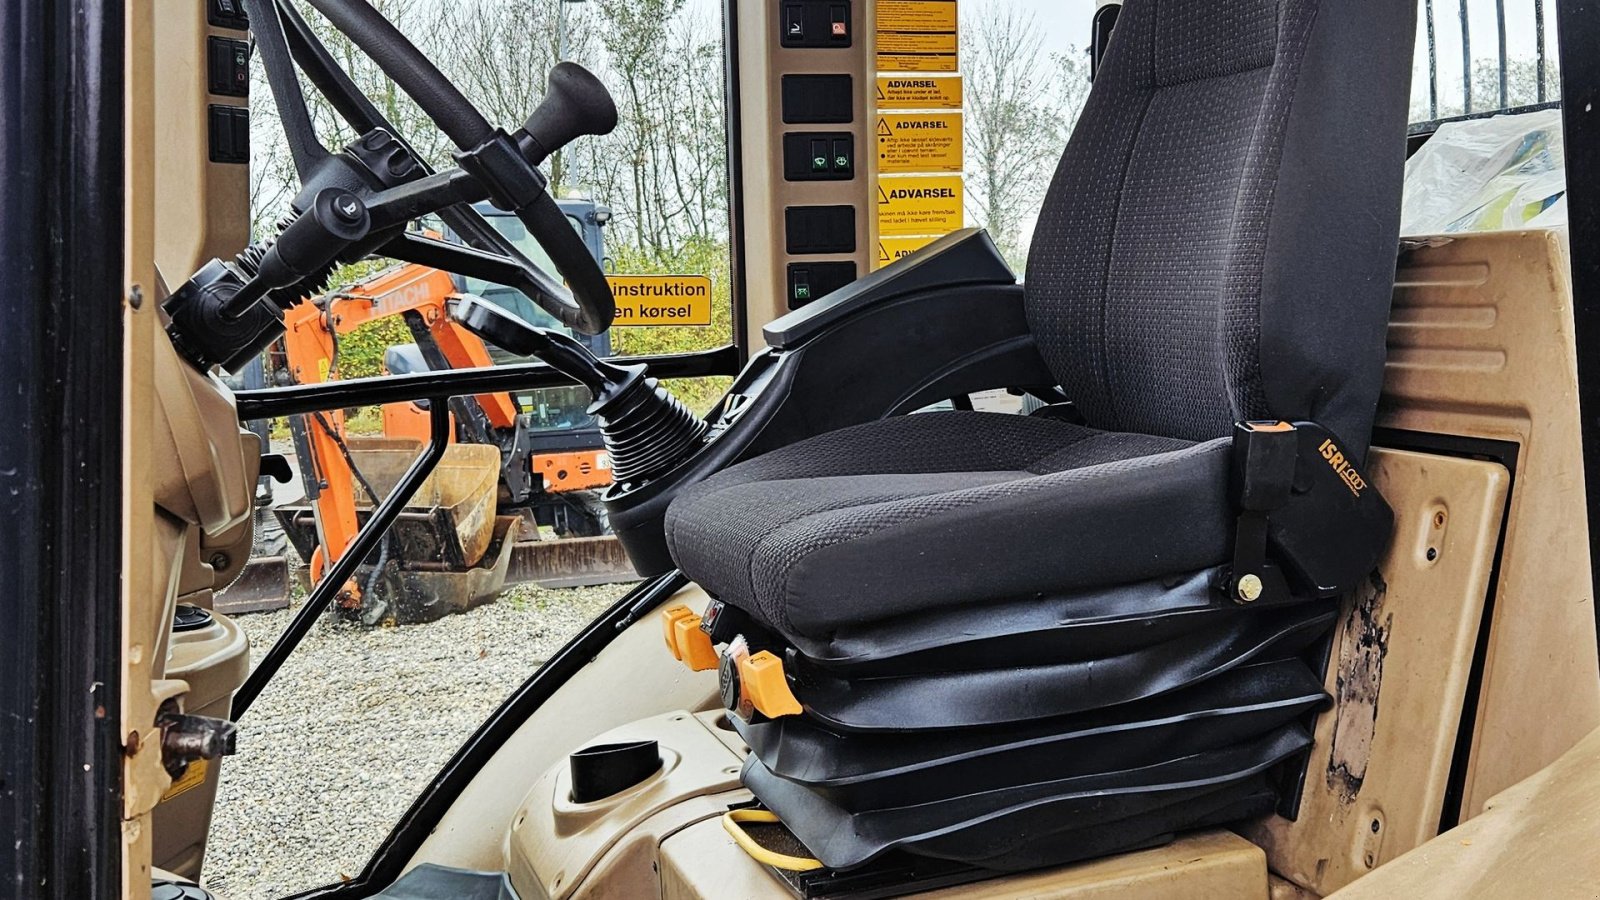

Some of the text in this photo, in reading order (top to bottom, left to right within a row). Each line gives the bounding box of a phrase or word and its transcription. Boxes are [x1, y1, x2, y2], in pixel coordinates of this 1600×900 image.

[887, 80, 937, 88] ADVARSEL
[896, 121, 948, 129] ADVARSEL
[890, 188, 956, 199] ADVARSEL
[613, 282, 706, 296] instruktion
[639, 304, 692, 318] kørsel
[1318, 438, 1349, 474] ISRI
